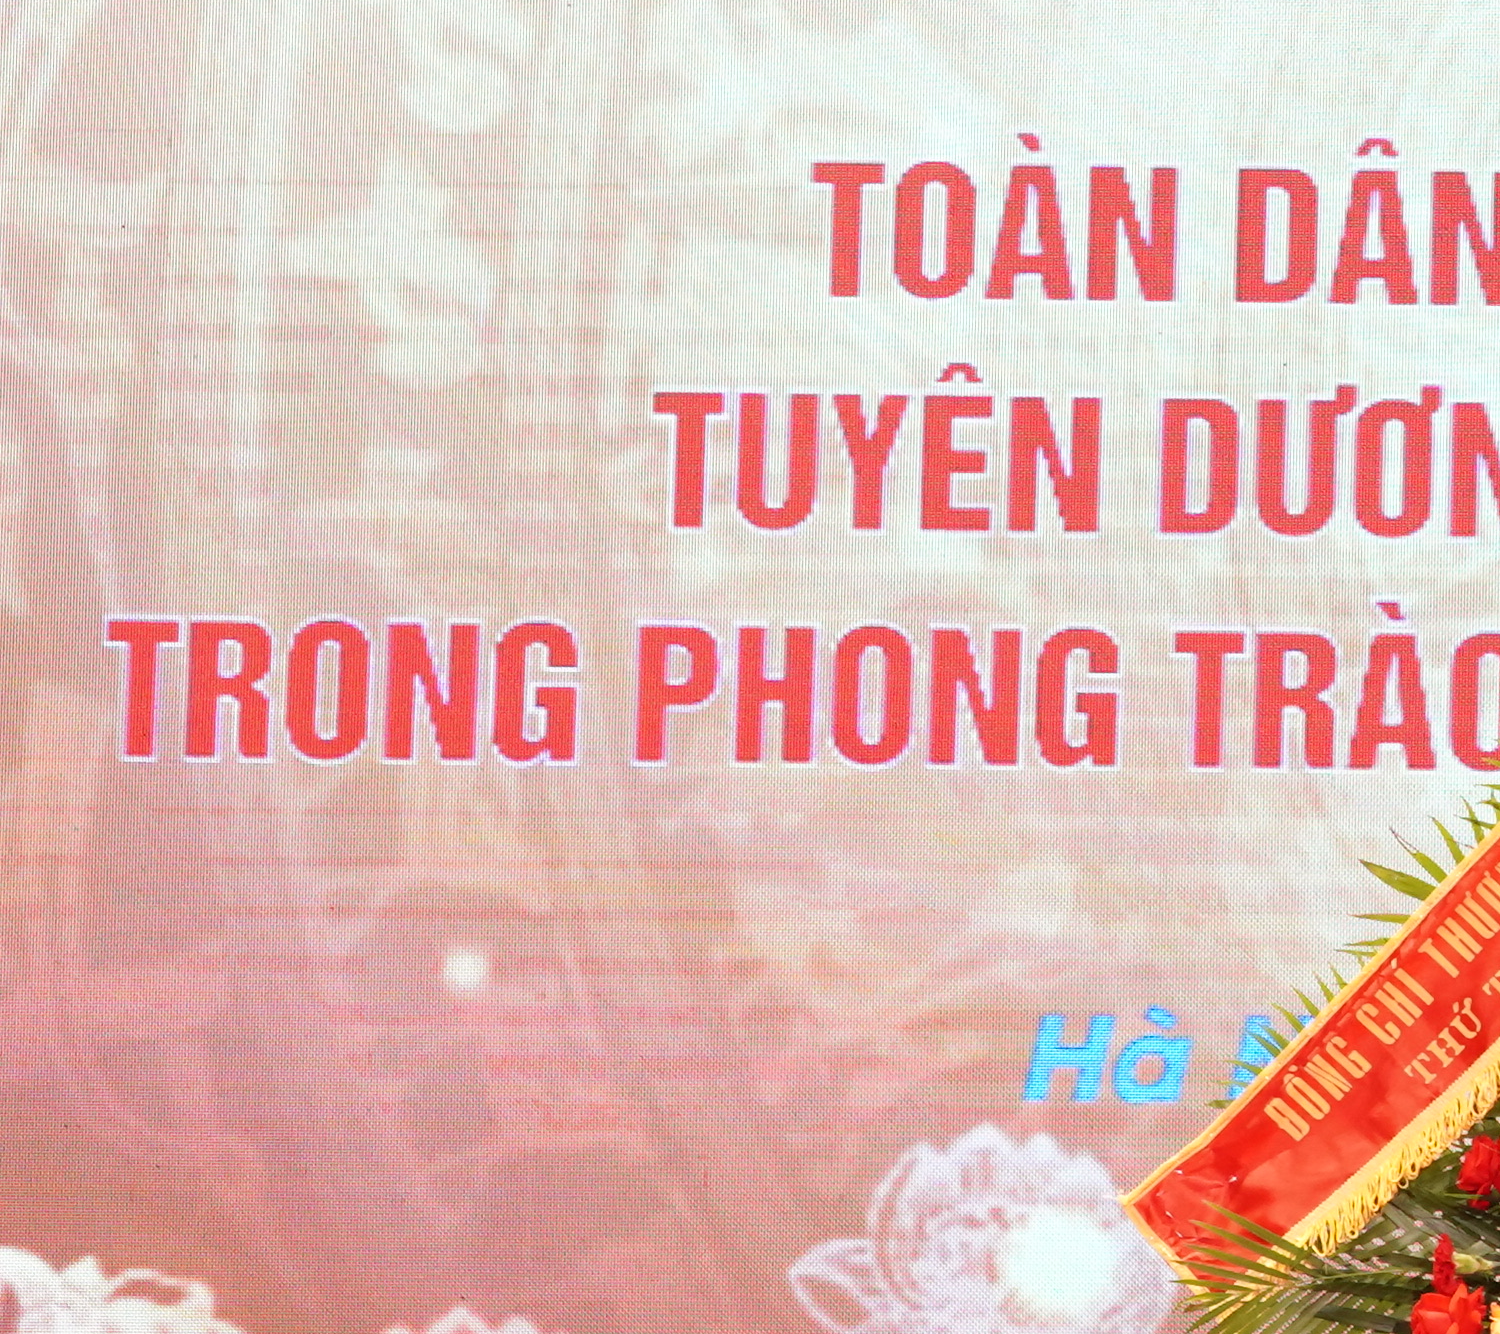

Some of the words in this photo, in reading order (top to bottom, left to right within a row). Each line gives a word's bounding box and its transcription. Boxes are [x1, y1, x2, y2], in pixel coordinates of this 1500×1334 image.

[814, 135, 1175, 301] TOÀN
[654, 365, 1100, 531] TUYÊN
[108, 621, 577, 761] TRONG
[635, 626, 1118, 766] PHONG
[1023, 1004, 1194, 1105] Hà
[1264, 1036, 1372, 1142] ĐỒNG
[1355, 958, 1434, 1045] CHÍ
[1404, 997, 1482, 1084] THỨ
